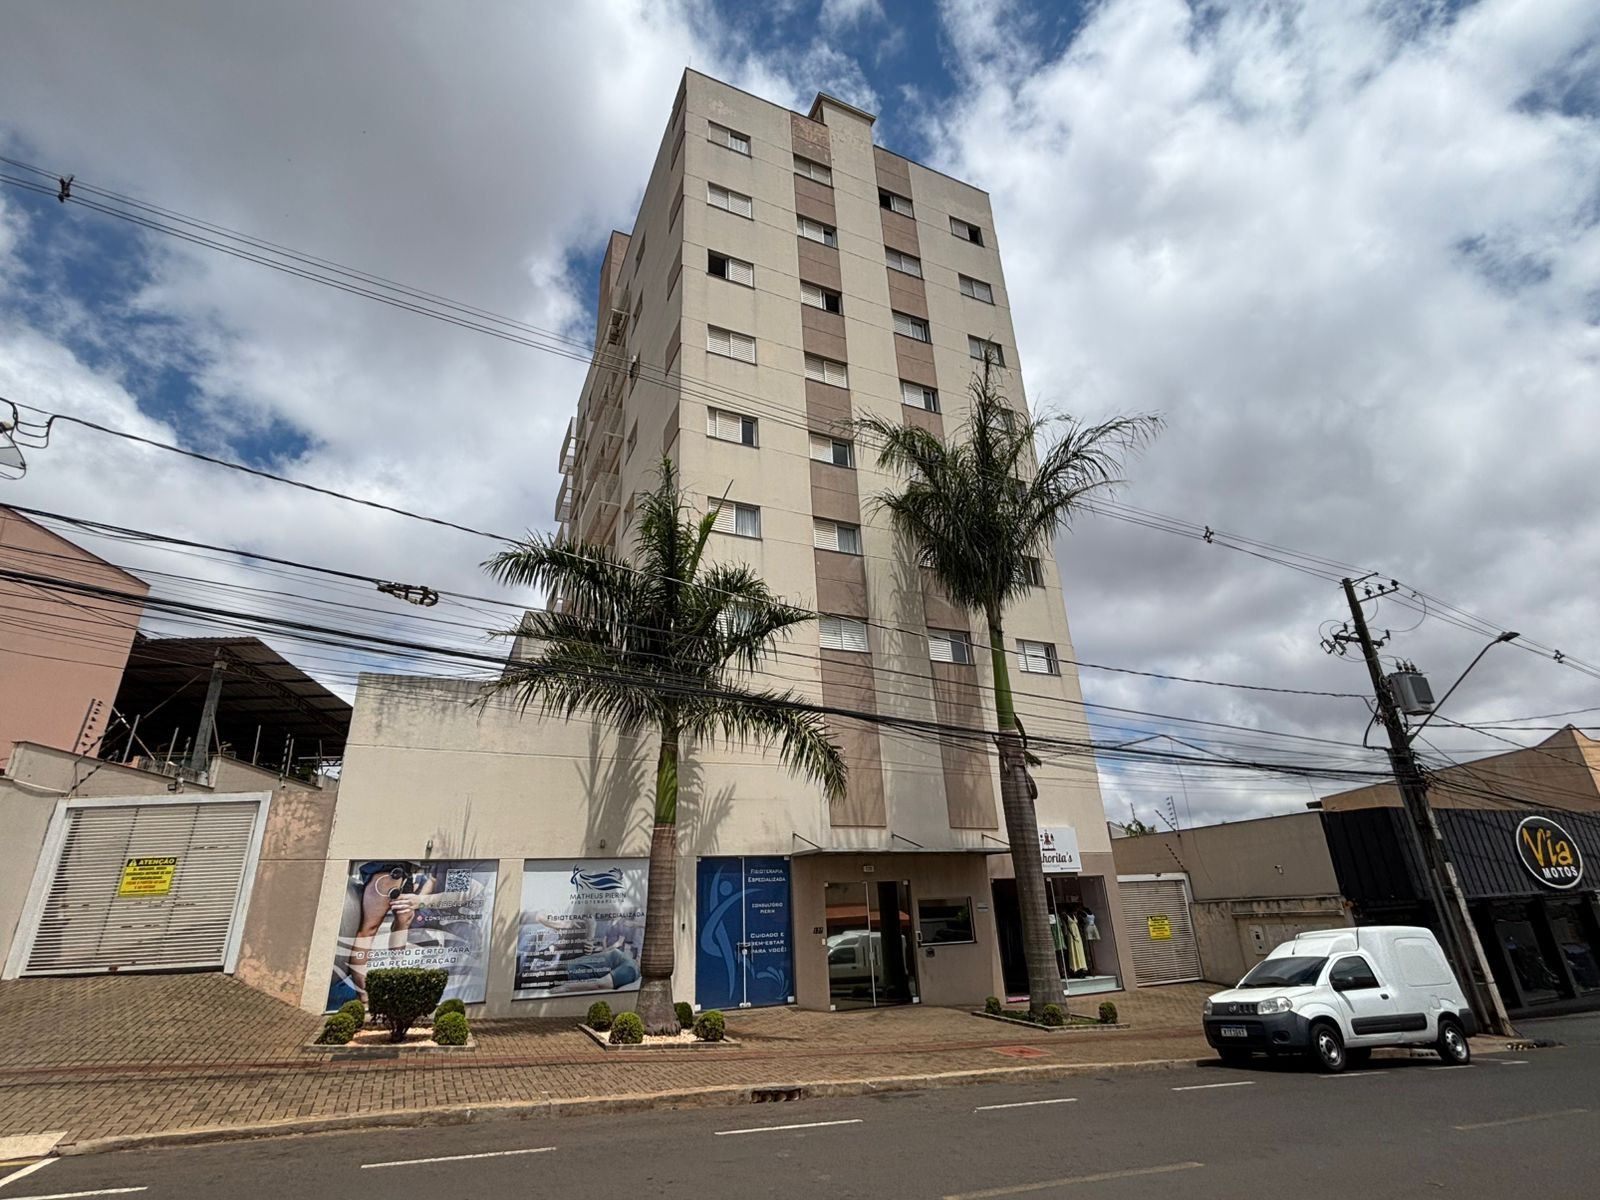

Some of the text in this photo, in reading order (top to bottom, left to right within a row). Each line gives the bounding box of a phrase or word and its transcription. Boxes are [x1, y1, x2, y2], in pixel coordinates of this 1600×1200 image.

[1521, 827, 1573, 867] Via
[1541, 866, 1578, 879] MOTOS
[367, 949, 411, 959] CAMINHO
[414, 948, 444, 956] CERTO
[448, 946, 470, 954] PARA
[366, 960, 385, 968] SUA
